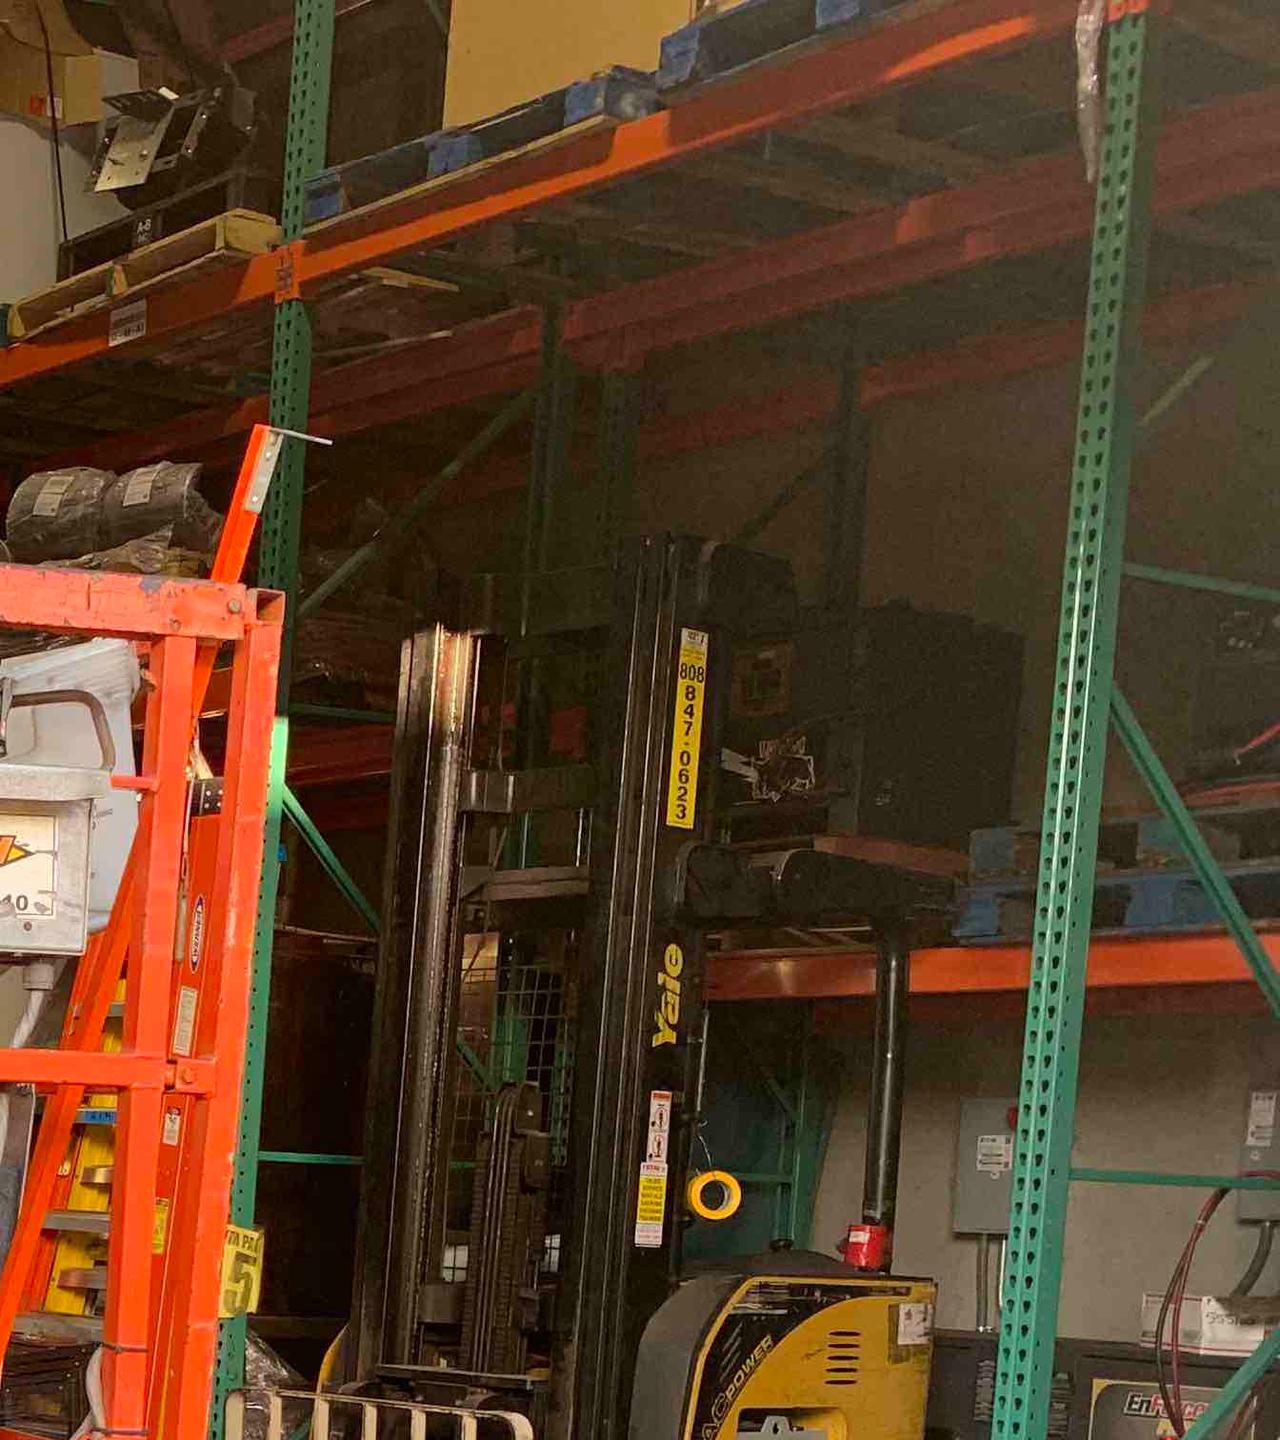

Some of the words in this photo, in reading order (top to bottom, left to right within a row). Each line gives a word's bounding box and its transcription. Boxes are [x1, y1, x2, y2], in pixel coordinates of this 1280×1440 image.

[679, 662, 706, 684] 808
[651, 942, 686, 1048] Yale
[225, 1250, 256, 1314] 5
